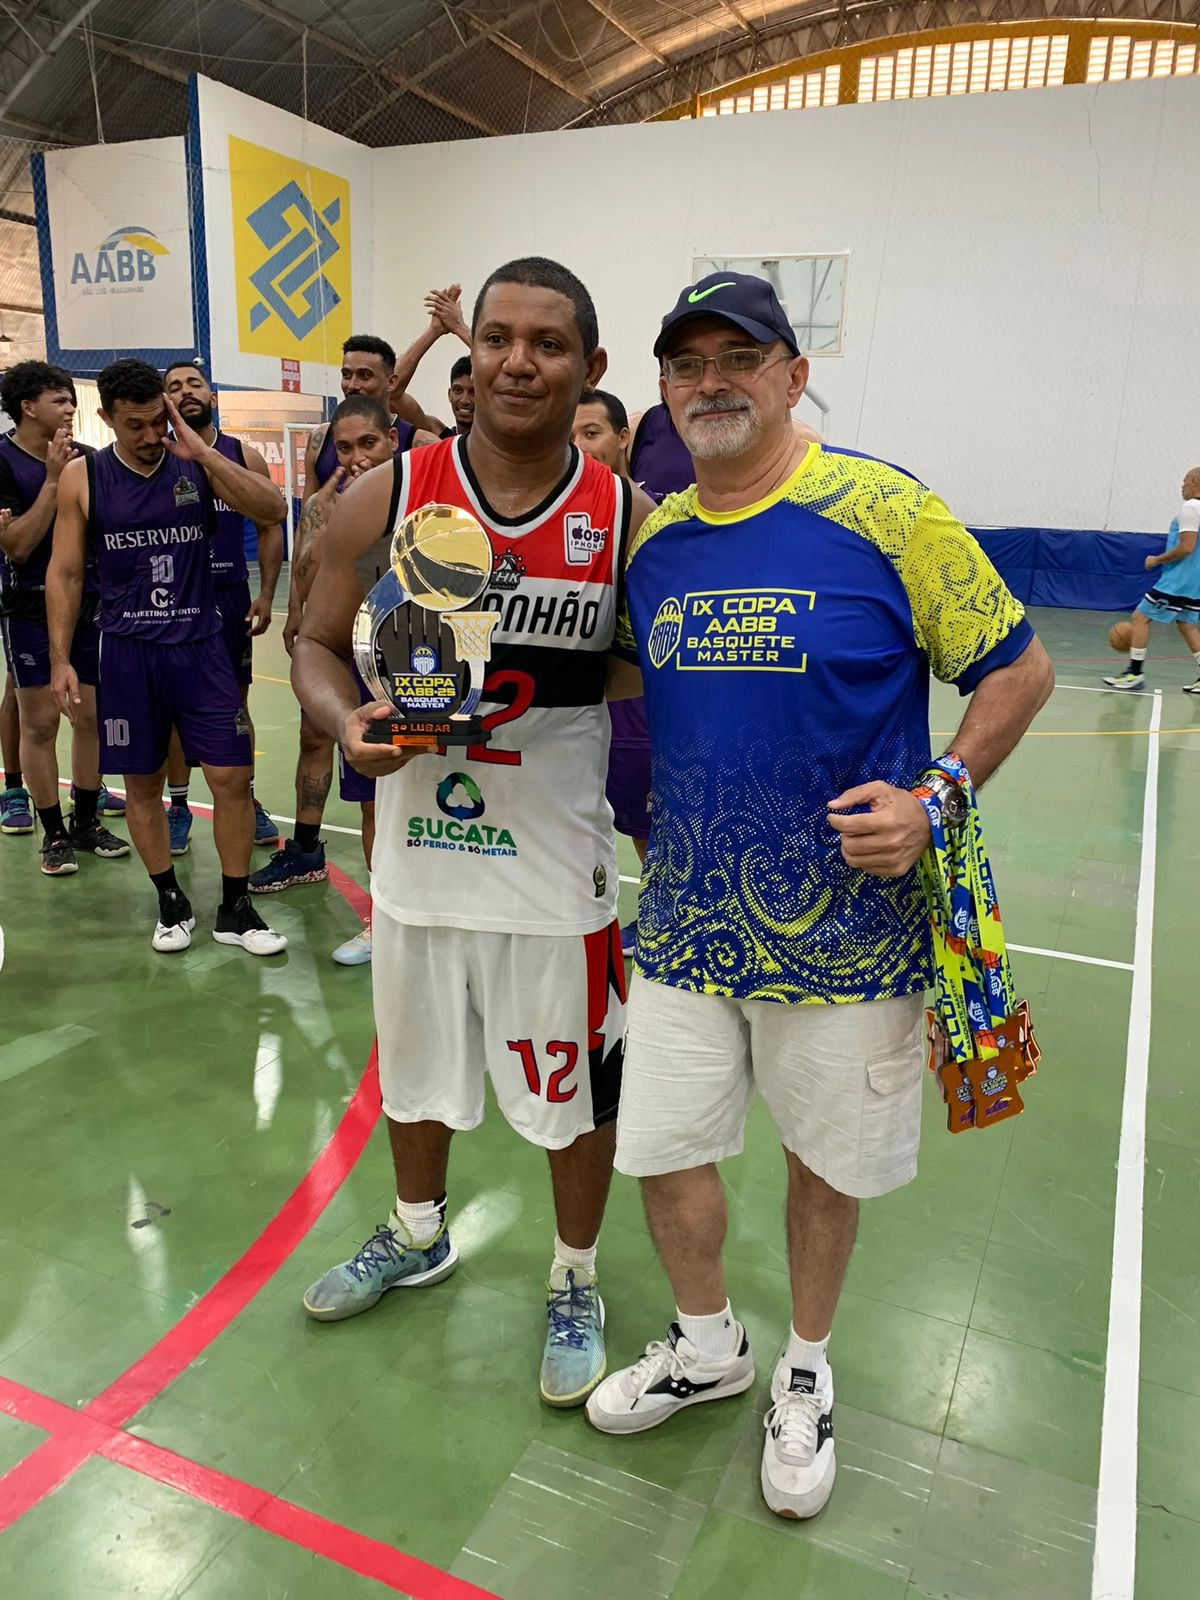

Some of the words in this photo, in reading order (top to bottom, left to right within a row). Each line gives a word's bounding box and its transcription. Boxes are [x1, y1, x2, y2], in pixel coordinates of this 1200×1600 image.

[71, 249, 156, 284] AABB
[104, 524, 203, 550] RESERVADOS
[150, 555, 175, 583] 10
[692, 600, 715, 616] IX
[722, 597, 797, 615] COPA
[705, 616, 777, 634] AABB
[686, 636, 796, 650] BASQUETE
[697, 650, 779, 662] MASTER
[20, 653, 36, 666] 2
[395, 677, 411, 687] IX
[413, 677, 455, 687] COPA
[104, 719, 130, 747] 10
[410, 723, 451, 732] LUGAR
[408, 816, 517, 848] SUCATA
[406, 838, 421, 848] SÓ
[423, 839, 456, 851] FERRO
[468, 846, 481, 855] SÓ
[482, 848, 518, 857] METAIS
[957, 910, 968, 938] AABB
[949, 978, 963, 1010] MASTER
[989, 968, 999, 997] AABB
[974, 1002, 988, 1030] AABB
[958, 1010, 972, 1051] BASQUETE
[506, 1039, 579, 1104] 12
